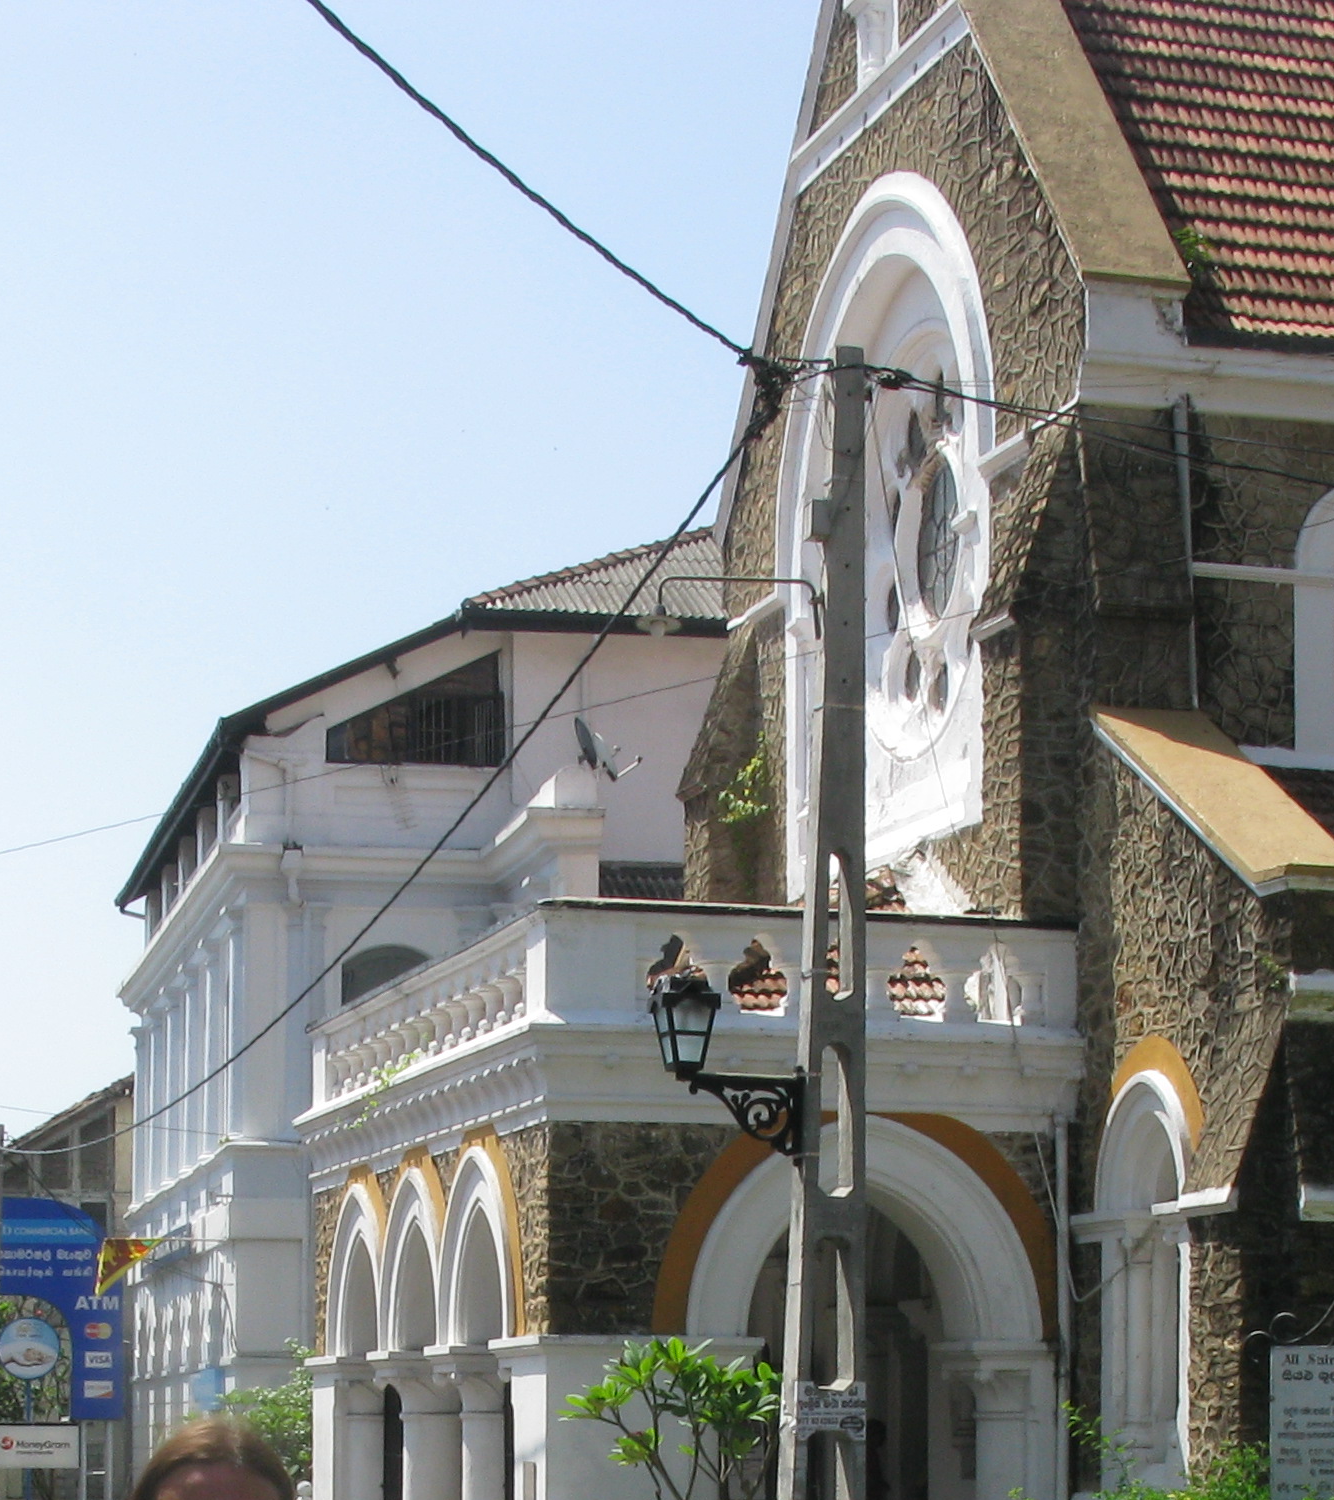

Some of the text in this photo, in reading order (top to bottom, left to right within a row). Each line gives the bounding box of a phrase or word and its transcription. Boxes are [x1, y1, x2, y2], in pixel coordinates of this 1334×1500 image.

[74, 1295, 120, 1311] ATM
[88, 1354, 111, 1364] VISA
[1281, 1353, 1299, 1366] All
[17, 1440, 71, 1450] MoneyGram
